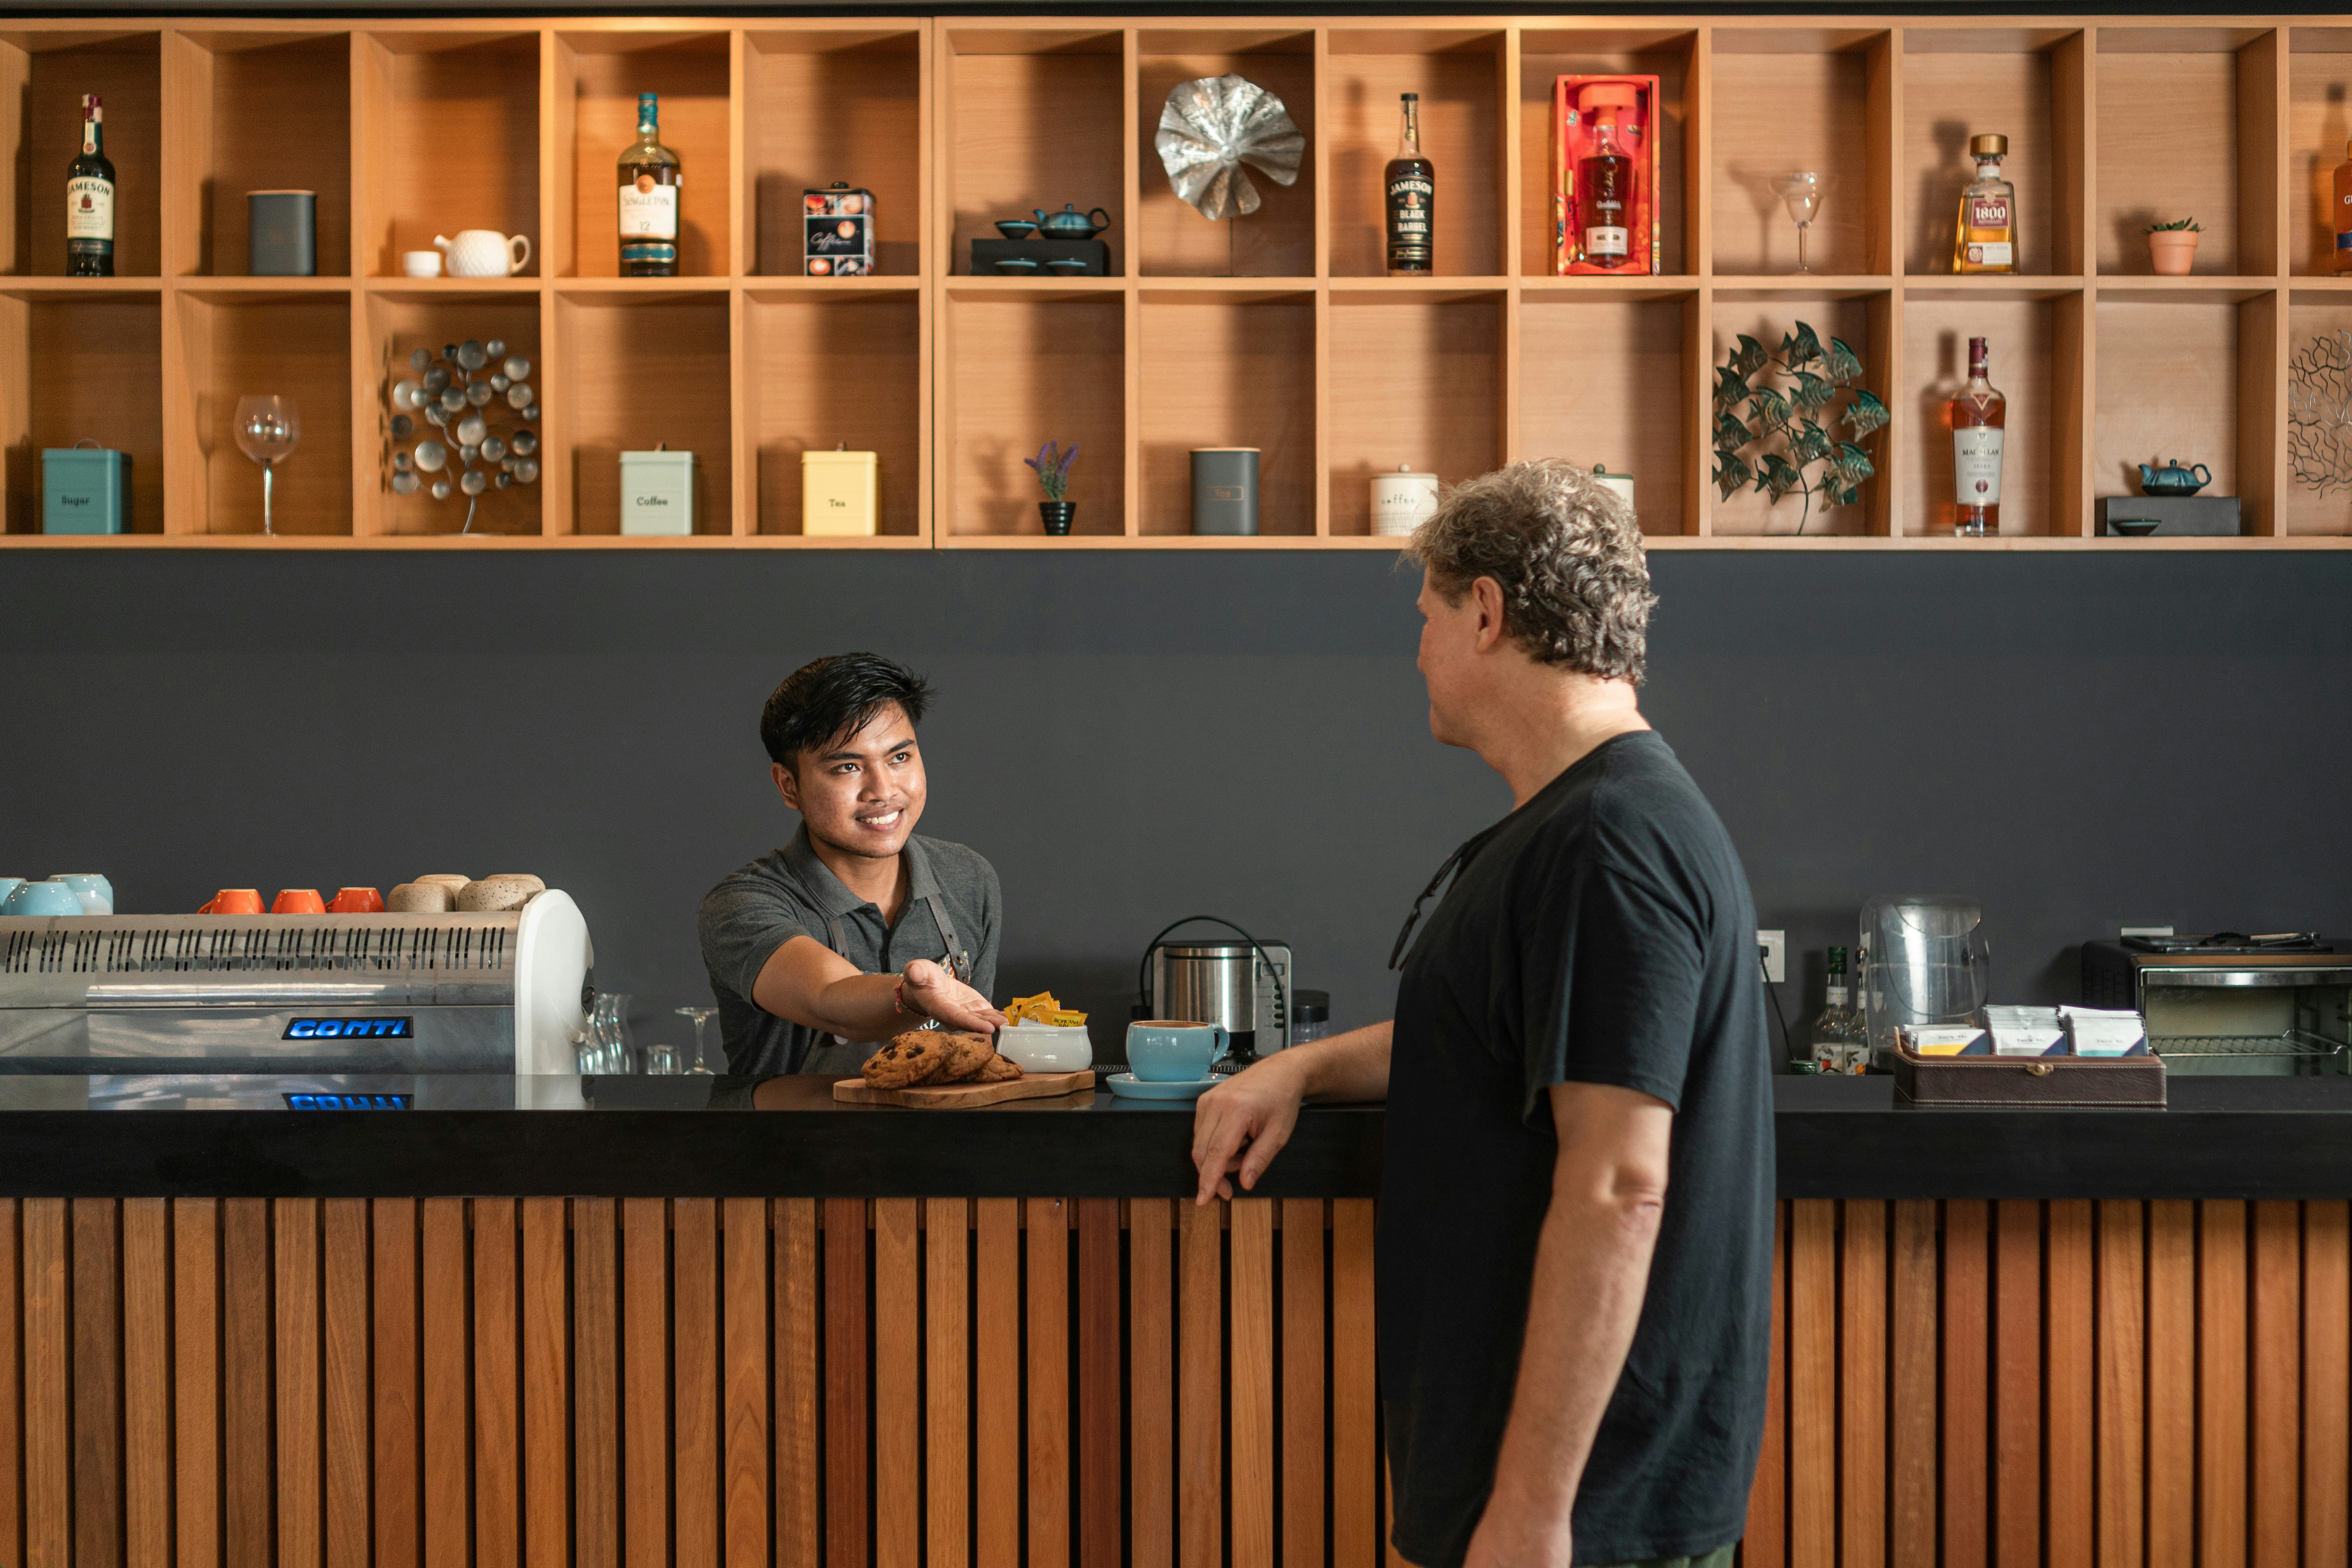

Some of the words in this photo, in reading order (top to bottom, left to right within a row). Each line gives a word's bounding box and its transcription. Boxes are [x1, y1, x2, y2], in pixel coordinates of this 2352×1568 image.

[68, 182, 110, 196] JAMESON
[1390, 181, 1432, 196] JAMESON
[1400, 210, 1425, 219] BLACK
[1975, 206, 2006, 221] 1800
[640, 221, 650, 231] 12
[1398, 222, 1428, 231] BARREL
[62, 495, 90, 508] Sugar
[636, 496, 668, 506] Coffee
[829, 499, 846, 507] Tea
[1382, 493, 1416, 504] coffee
[289, 1020, 406, 1037] CONTI
